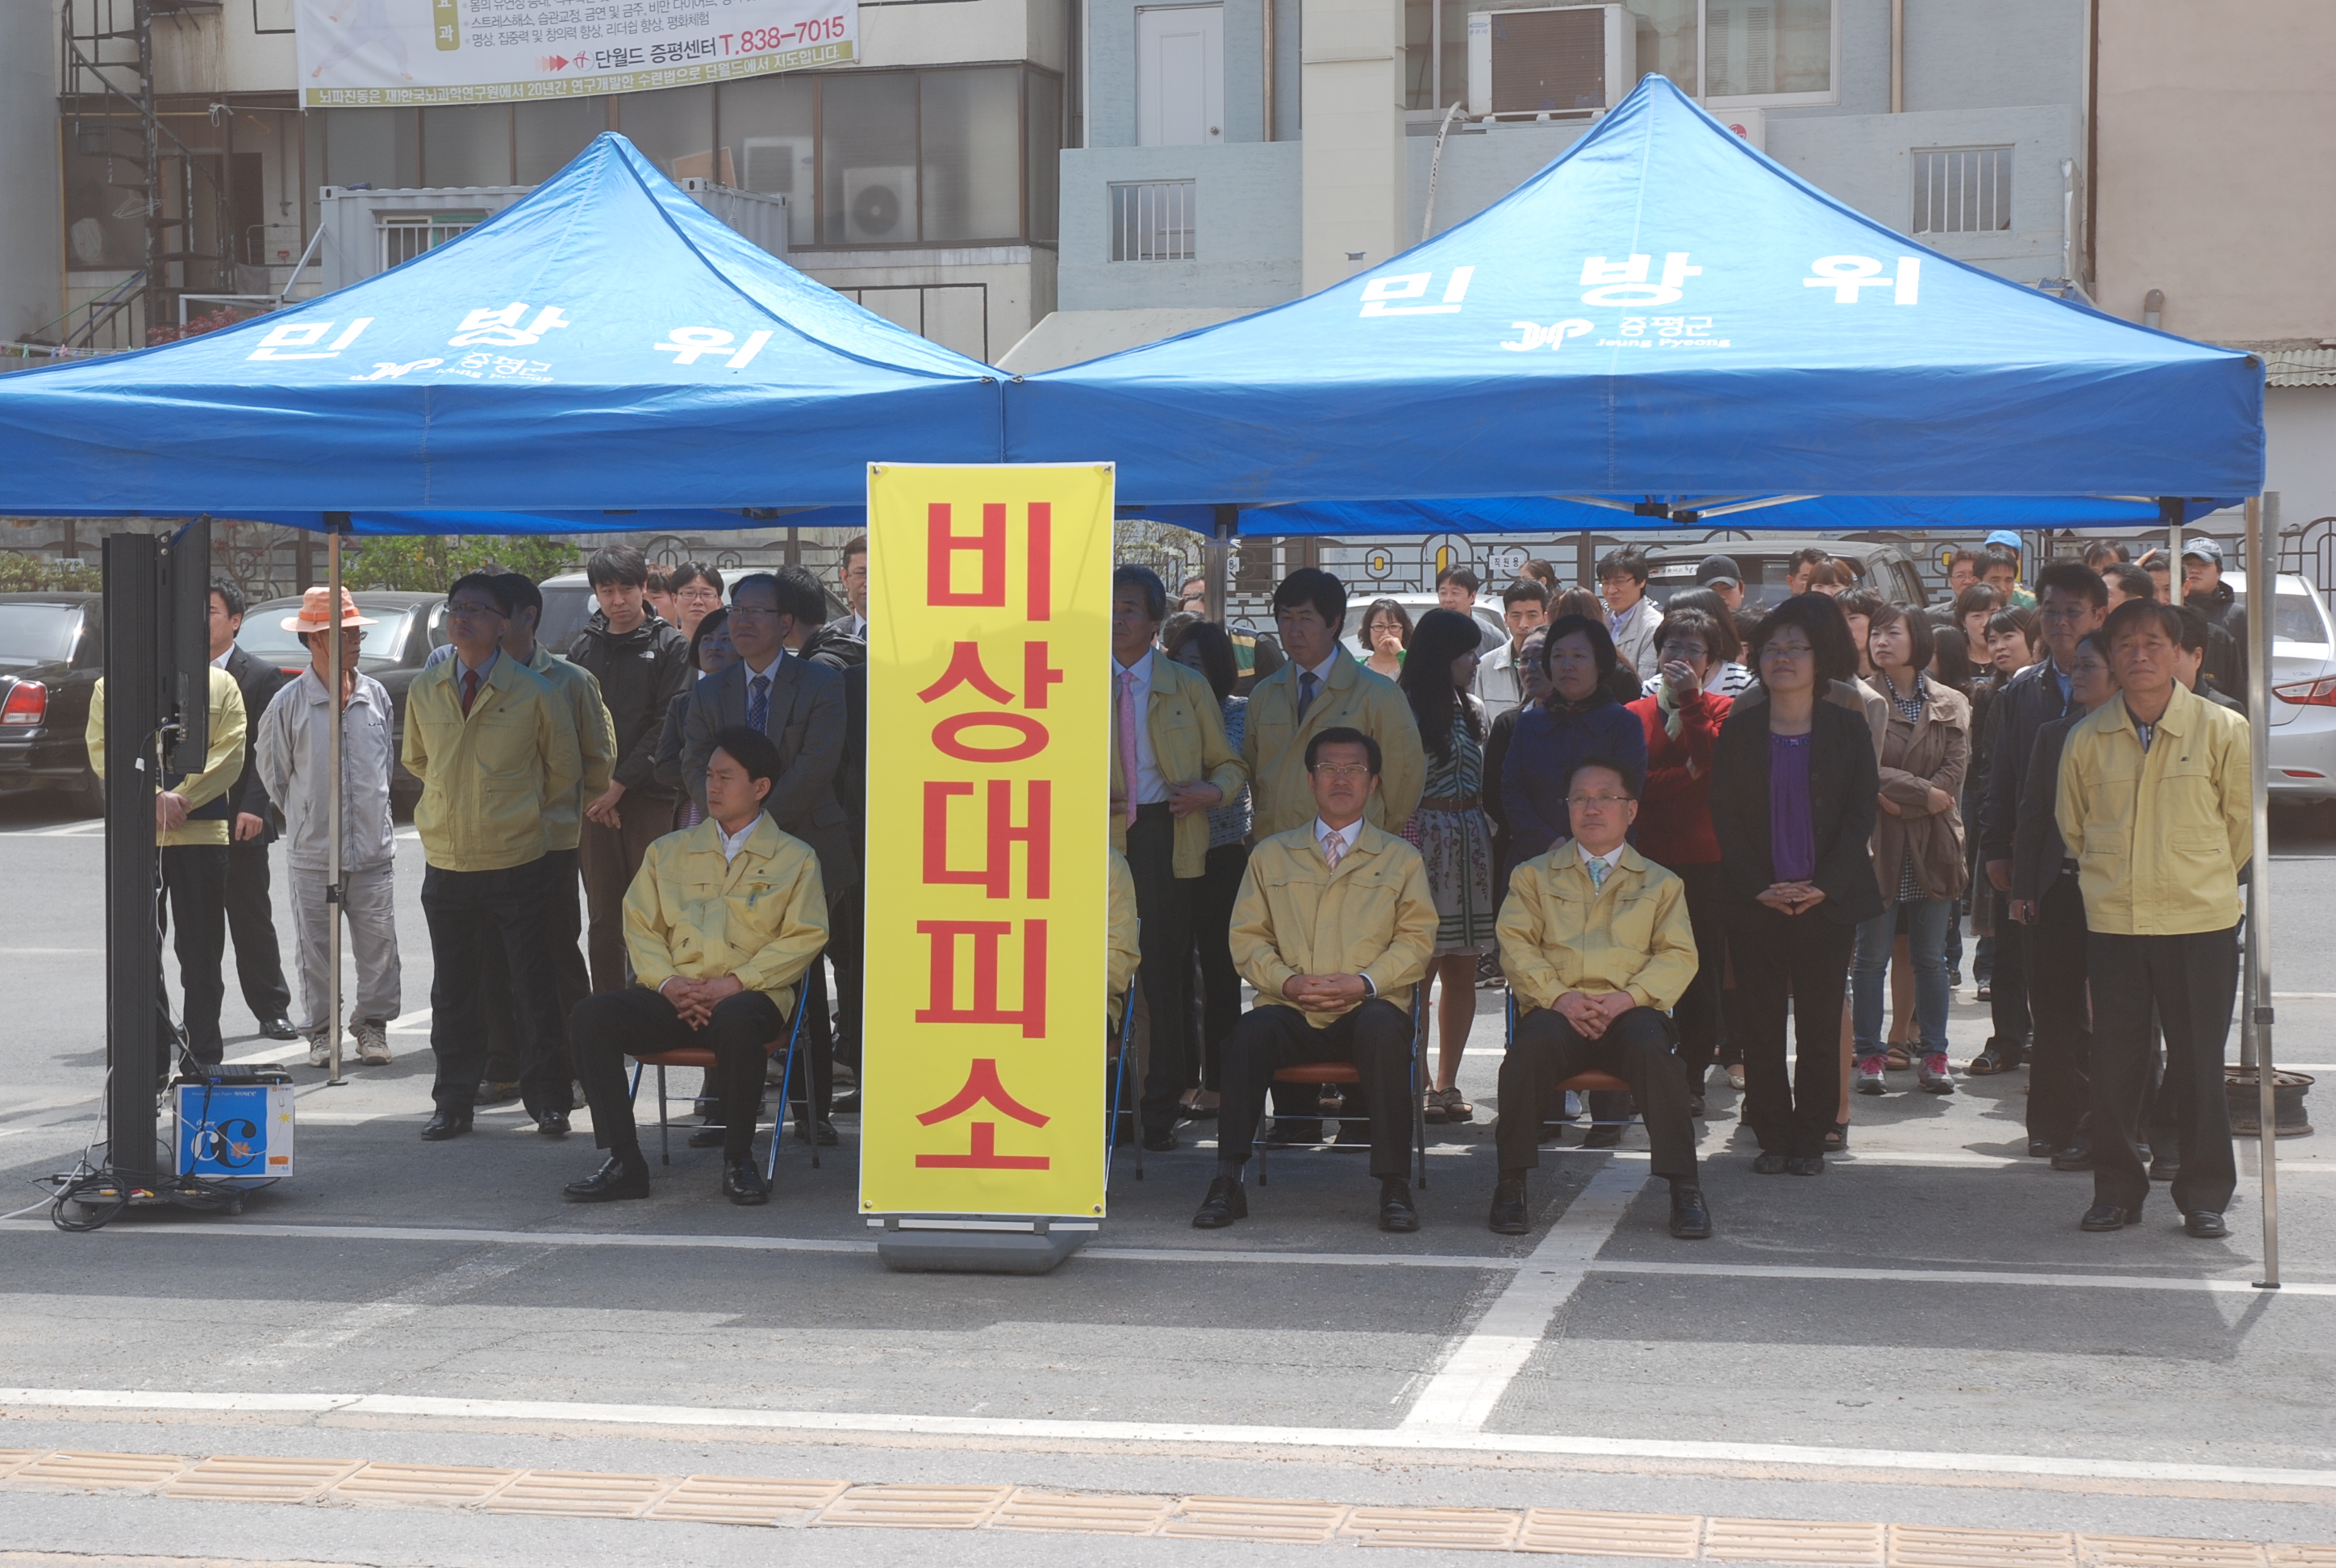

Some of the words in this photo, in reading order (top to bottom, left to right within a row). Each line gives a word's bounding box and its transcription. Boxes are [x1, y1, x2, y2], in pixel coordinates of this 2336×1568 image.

[471, 14, 534, 28] 스트레스해소,
[537, 9, 581, 25] 습관교정,
[585, 6, 606, 22] 금연
[609, 5, 619, 19] 및
[622, 2, 646, 18] 금주,
[649, 0, 670, 15] 비만
[473, 32, 494, 47] 명상,
[498, 30, 528, 45] 집중력
[532, 29, 542, 44] 및
[546, 27, 577, 42] 창의력
[580, 24, 603, 40] 향상,
[607, 20, 637, 35] 리더쉽
[640, 17, 664, 33] 향상,
[667, 11, 710, 30] 평화체험
[595, 48, 645, 69] 단월드
[650, 37, 716, 64] 증평센터
[319, 90, 381, 104] 뇌파진동은
[528, 81, 567, 97] 20년간
[571, 74, 635, 94] 연구개발한
[638, 67, 701, 87] 수련법으로
[706, 56, 770, 80] 단월드에서
[774, 45, 840, 69] 지도합니다.
[1620, 316, 1713, 337] 증평군
[1596, 338, 1653, 348] Jeung
[1658, 338, 1732, 348] Pyeong
[461, 352, 553, 376] 증평군
[915, 501, 1064, 1170] 비상대피소
